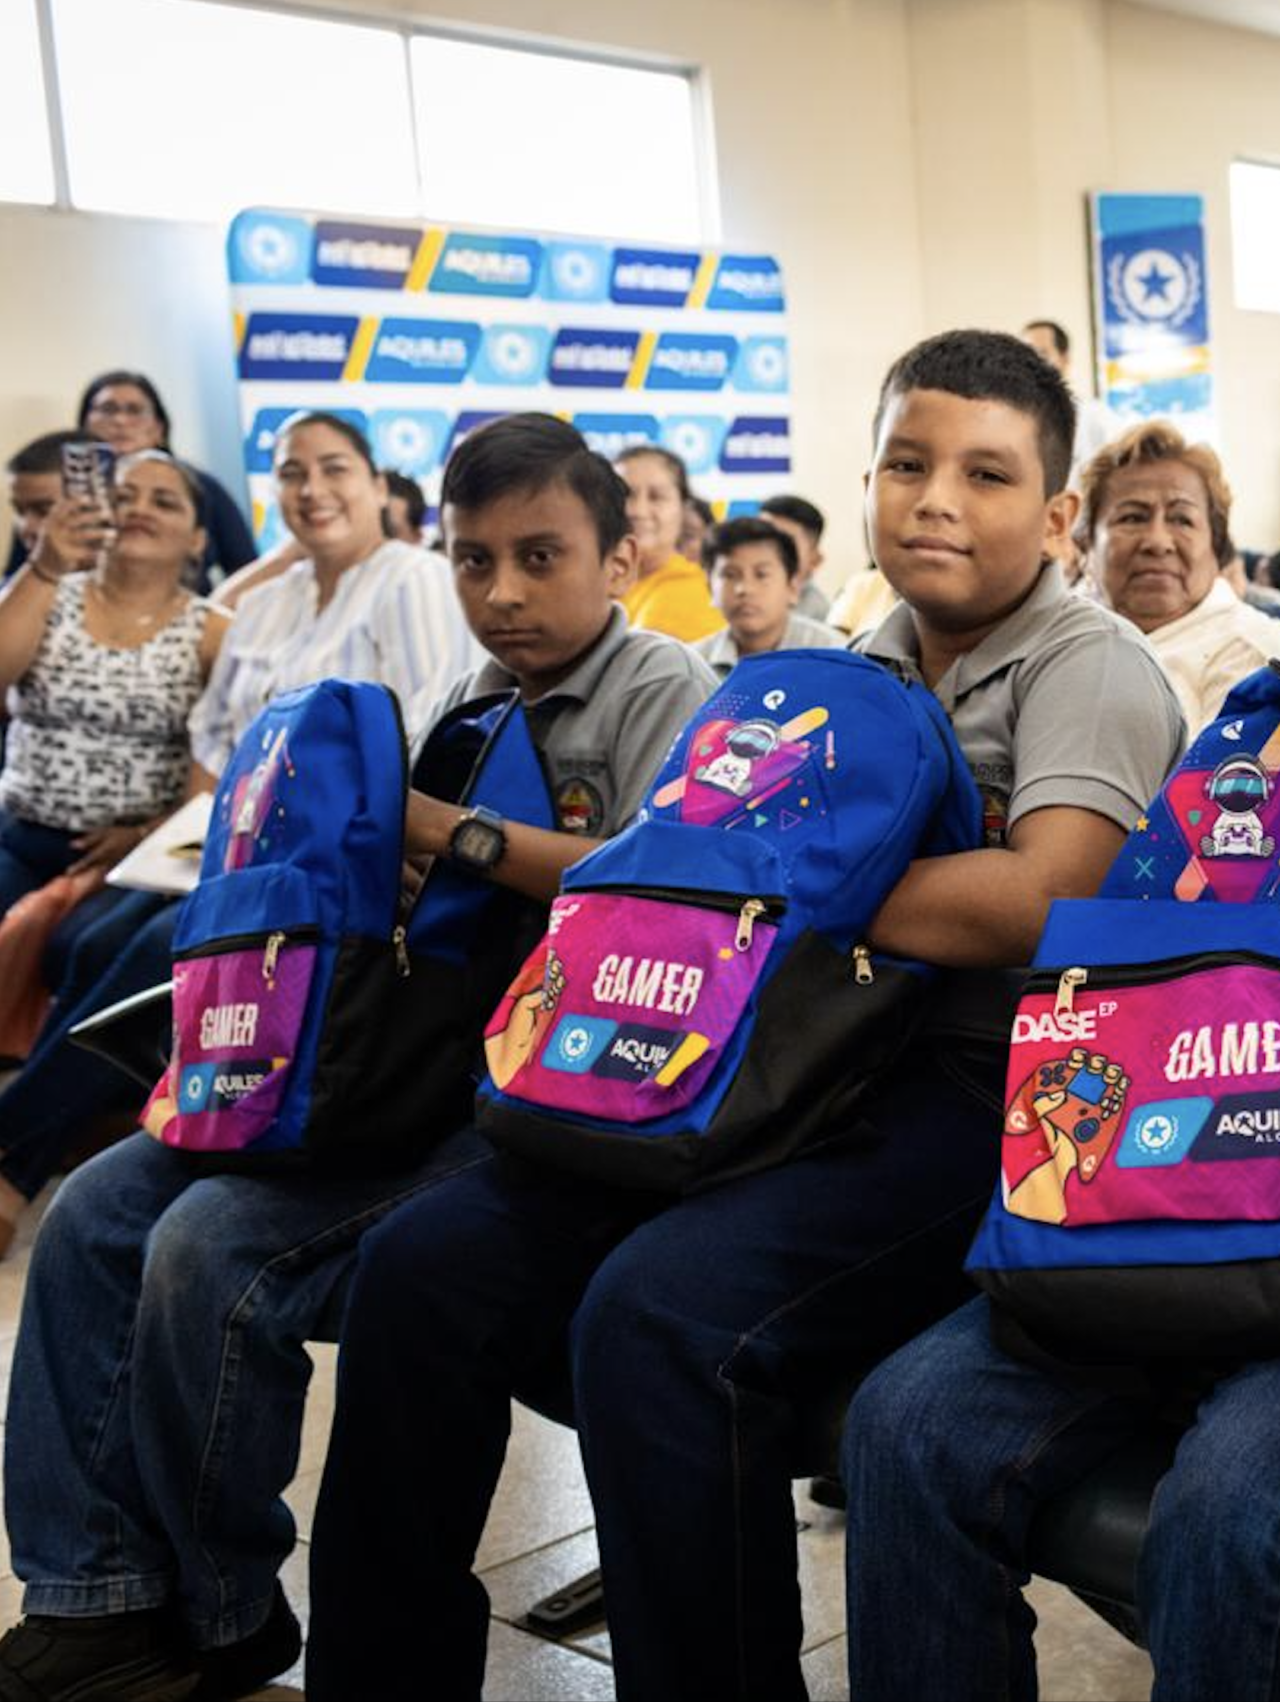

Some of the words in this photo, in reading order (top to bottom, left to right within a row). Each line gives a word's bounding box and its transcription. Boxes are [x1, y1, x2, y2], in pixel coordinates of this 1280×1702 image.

[592, 954, 704, 1015] GAMER
[200, 1003, 259, 1050] GAMER
[1011, 1010, 1097, 1044] DASE
[1099, 1002, 1118, 1016] EP
